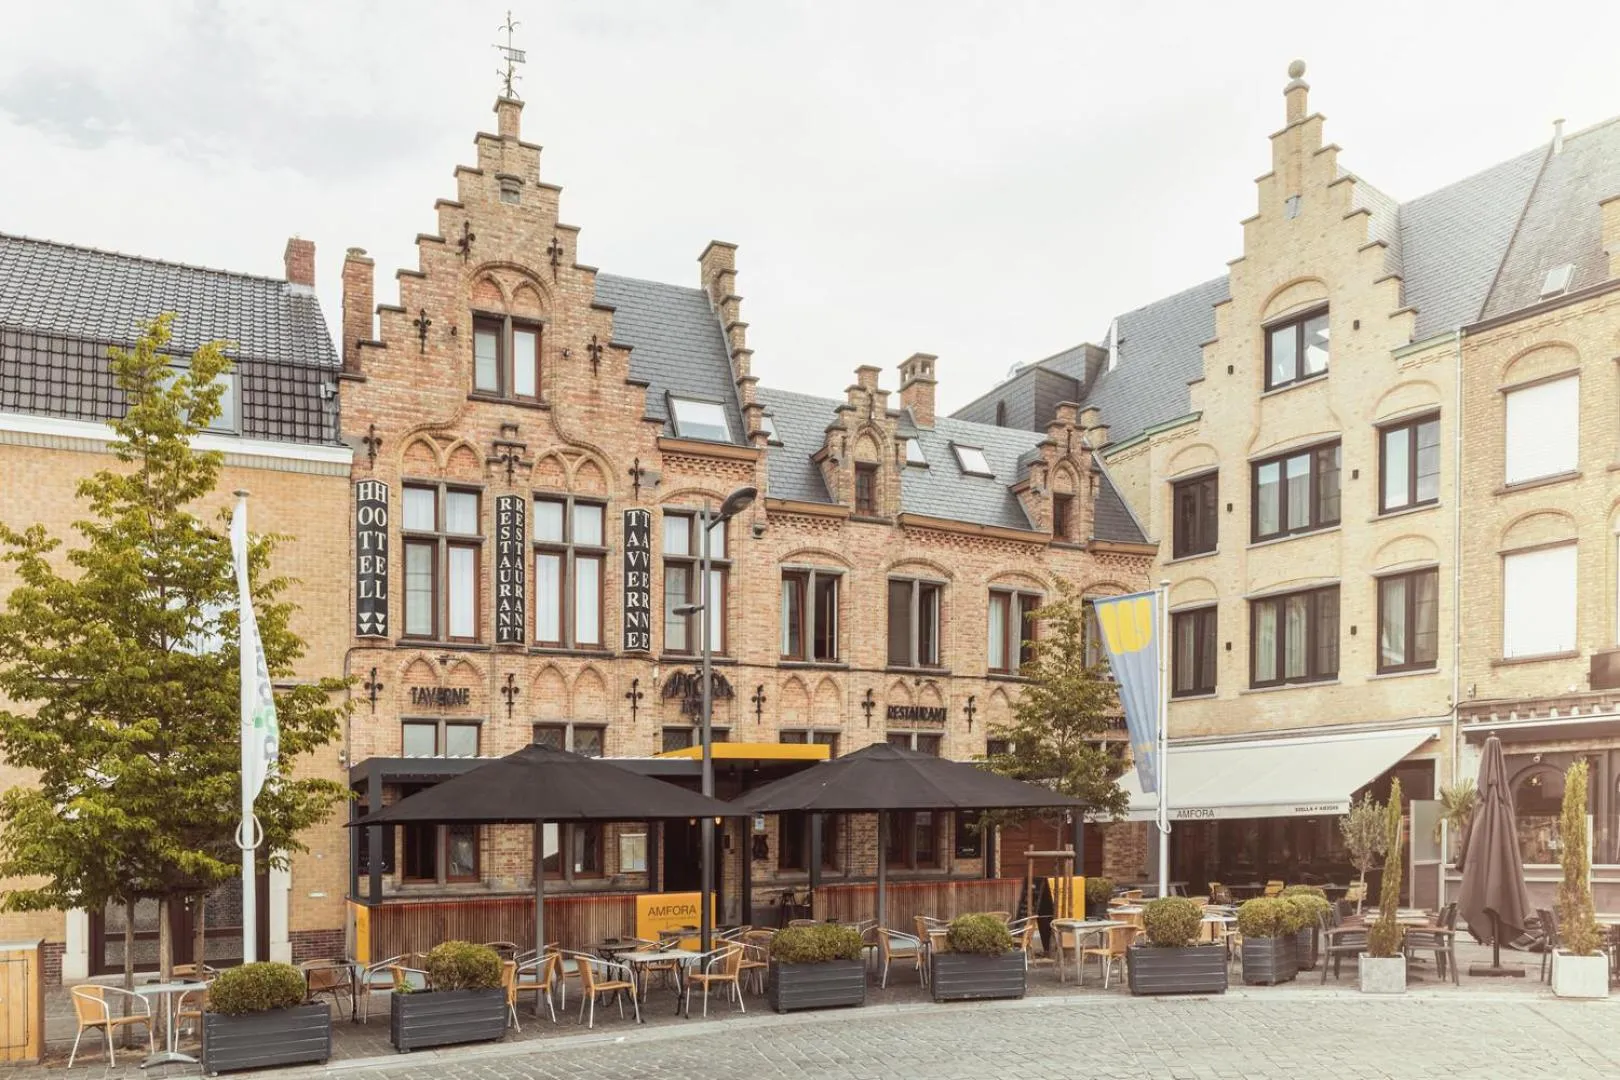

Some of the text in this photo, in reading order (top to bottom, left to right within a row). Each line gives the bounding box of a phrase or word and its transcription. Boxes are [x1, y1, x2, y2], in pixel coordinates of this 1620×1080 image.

[358, 482, 373, 599] HOTEL
[374, 482, 387, 600] HOTEL
[499, 498, 512, 640] RESTAURANT
[515, 499, 523, 641] RESTAURANT
[626, 511, 640, 648] TAVERNE
[641, 511, 650, 649] TAVERNE
[887, 705, 948, 722] RESTAURANT
[1176, 808, 1215, 819] AMFORA
[647, 904, 697, 917] AMFORA
